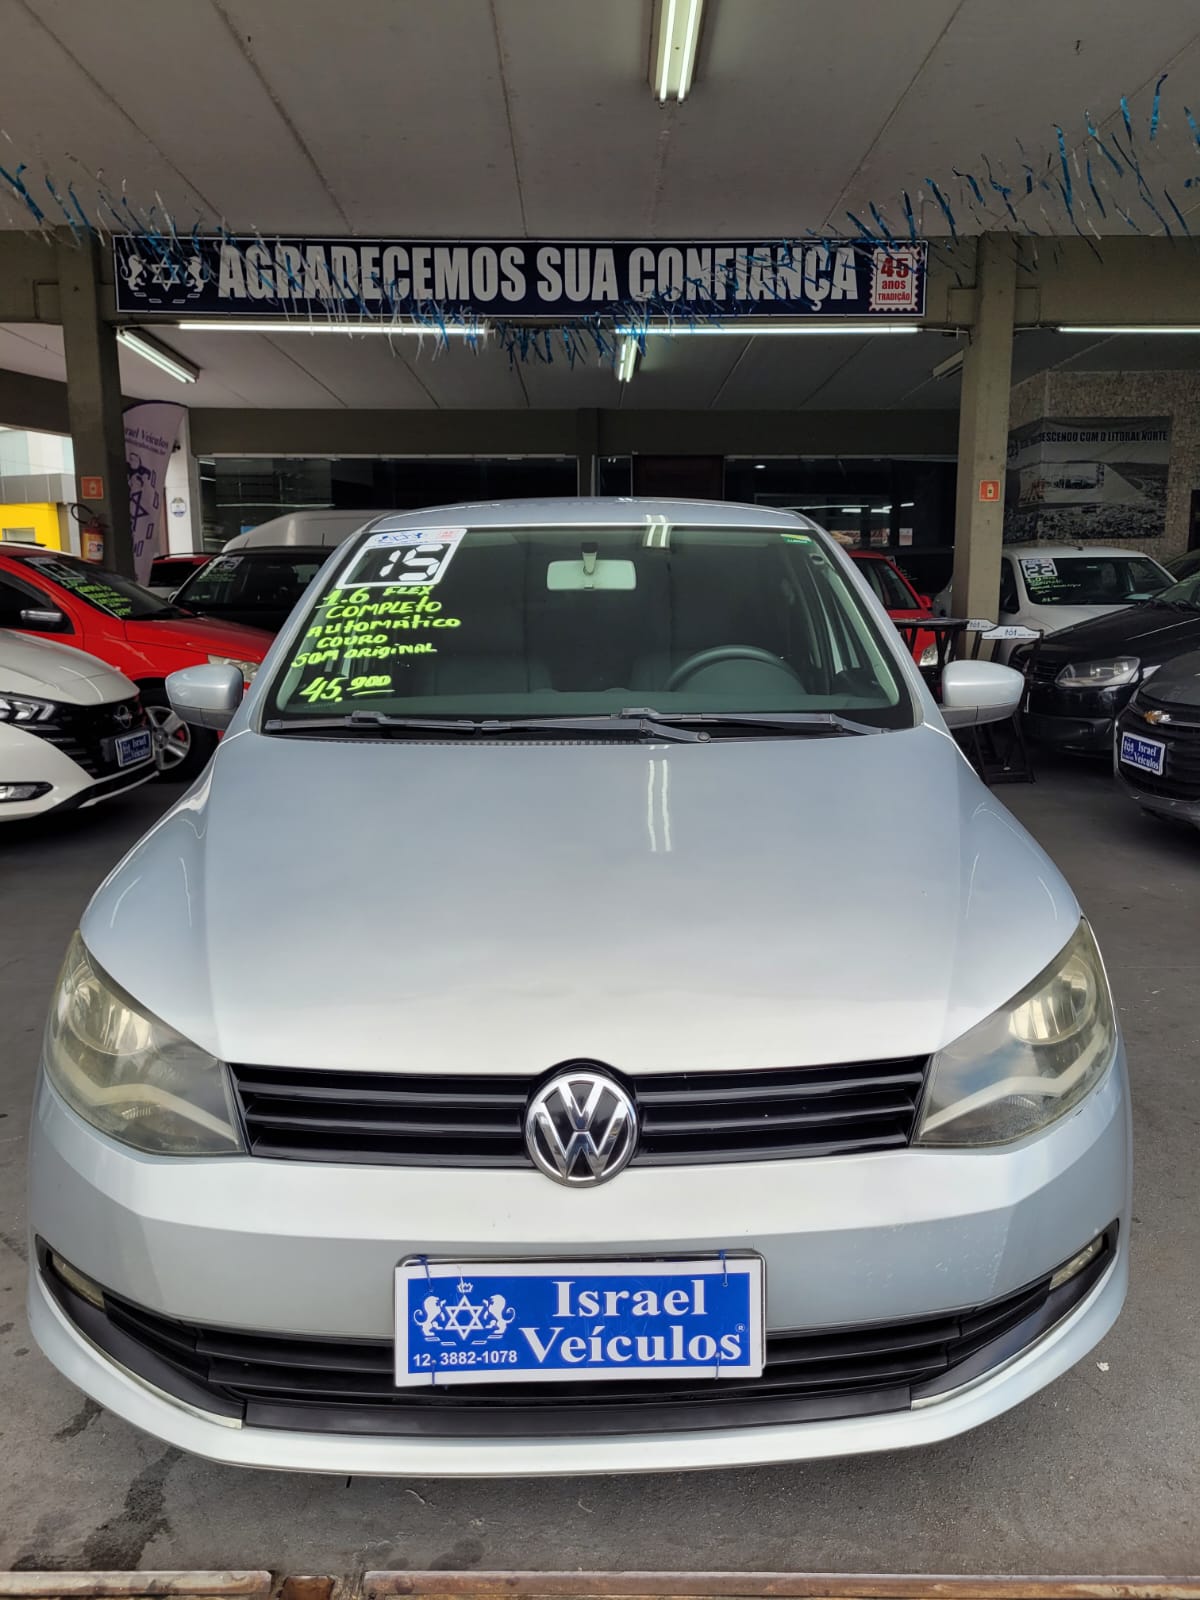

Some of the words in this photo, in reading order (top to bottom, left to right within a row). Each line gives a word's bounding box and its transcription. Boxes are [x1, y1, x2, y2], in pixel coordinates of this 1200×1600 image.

[881, 257, 909, 278] 45
[218, 245, 526, 301] AGRADECEMOS
[536, 247, 618, 301] SUA
[628, 246, 858, 311] CONFIANÇA
[882, 280, 906, 290] anos
[878, 291, 911, 302] TRADIÇÃO
[379, 544, 443, 581] 15
[316, 634, 388, 648] COURO
[291, 649, 339, 668] SOM
[1138, 742, 1157, 756] Israel
[552, 1279, 708, 1317] Israel
[518, 1325, 742, 1363] Veículos
[440, 1350, 518, 1365] 3882-1078
